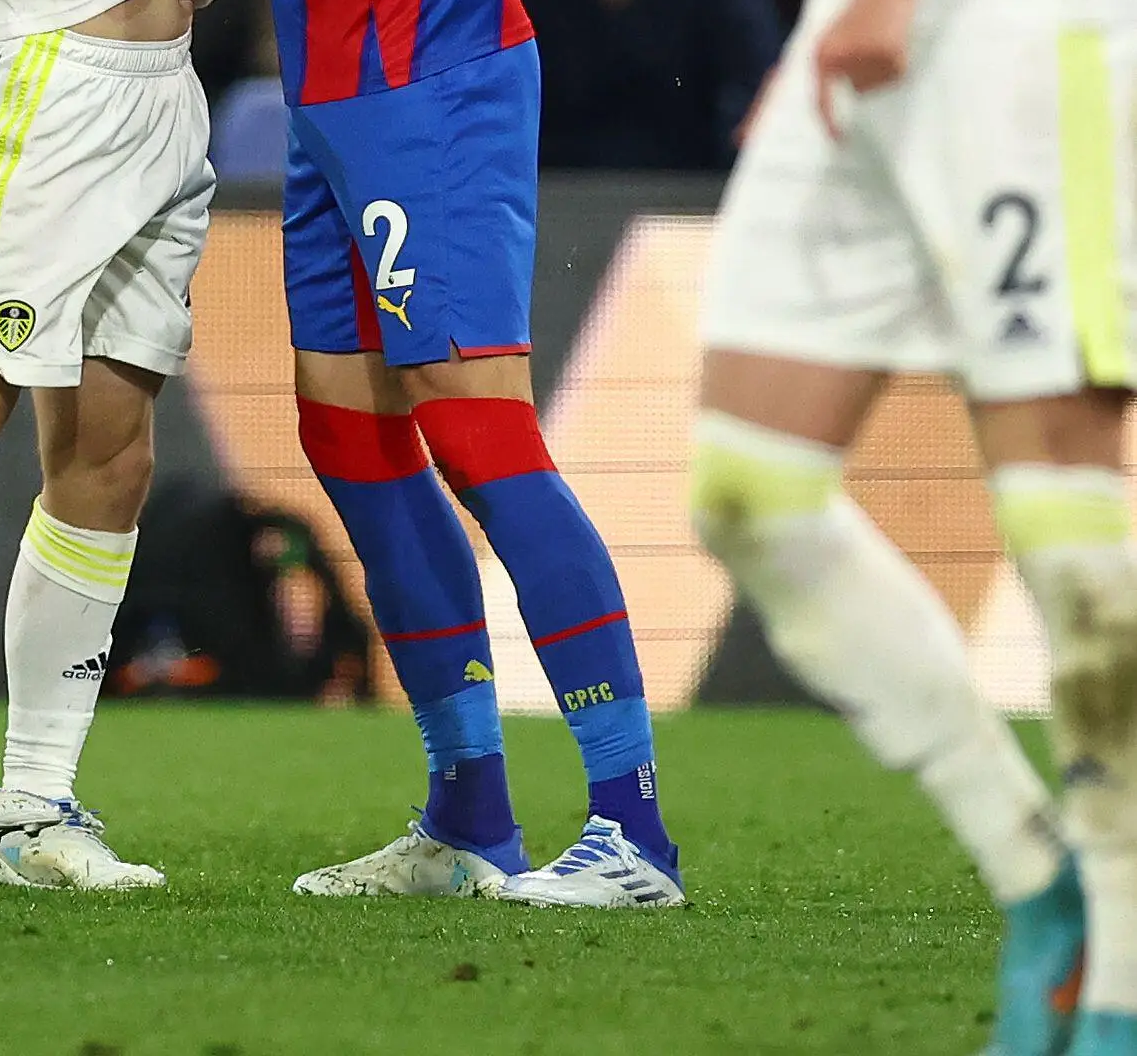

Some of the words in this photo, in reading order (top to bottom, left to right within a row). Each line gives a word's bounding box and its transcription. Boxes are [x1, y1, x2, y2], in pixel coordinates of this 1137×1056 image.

[362, 199, 416, 291] 2
[980, 190, 1048, 298] 2
[62, 668, 101, 681] adid
[564, 681, 615, 712] CPFC
